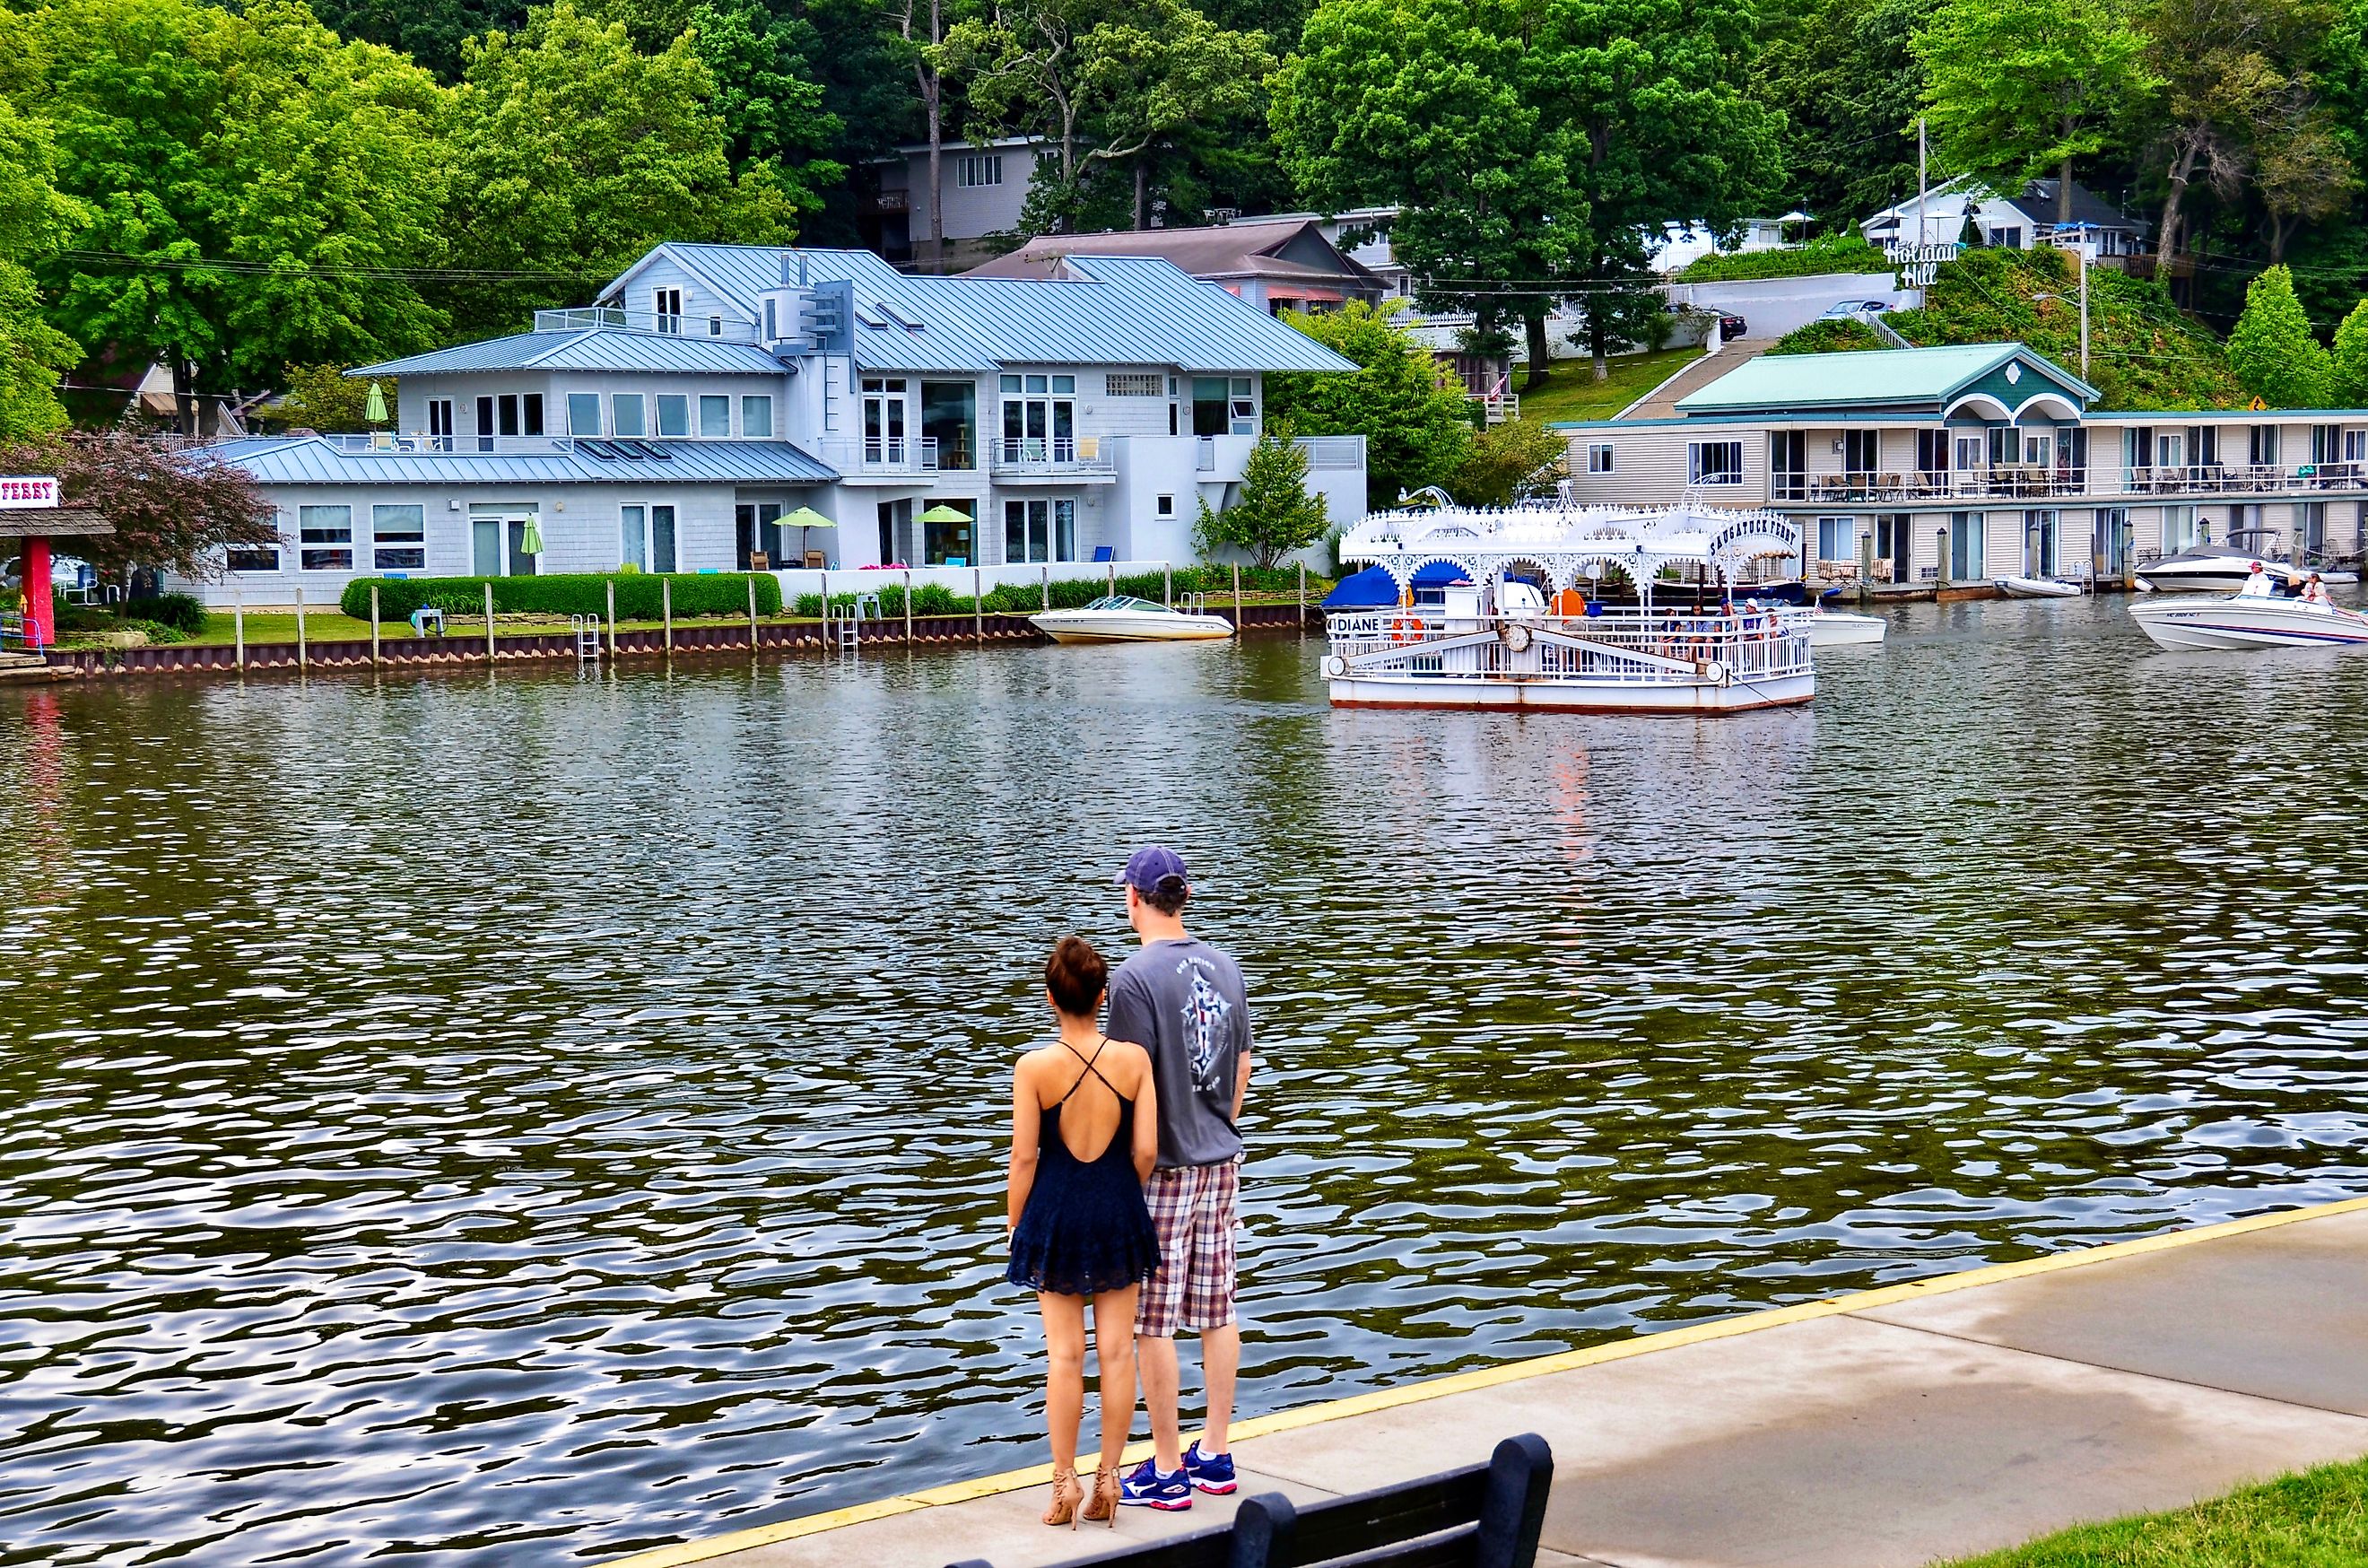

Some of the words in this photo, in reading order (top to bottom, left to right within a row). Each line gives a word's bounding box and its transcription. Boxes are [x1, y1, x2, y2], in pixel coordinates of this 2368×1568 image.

[1883, 241, 1956, 264] Holiday
[1901, 263, 1937, 287] Hill
[2, 483, 52, 500] FERRY
[1711, 519, 1767, 556] SAUGATUCK
[1771, 520, 1796, 545] FERRY
[1337, 618, 1379, 631] DIANE
